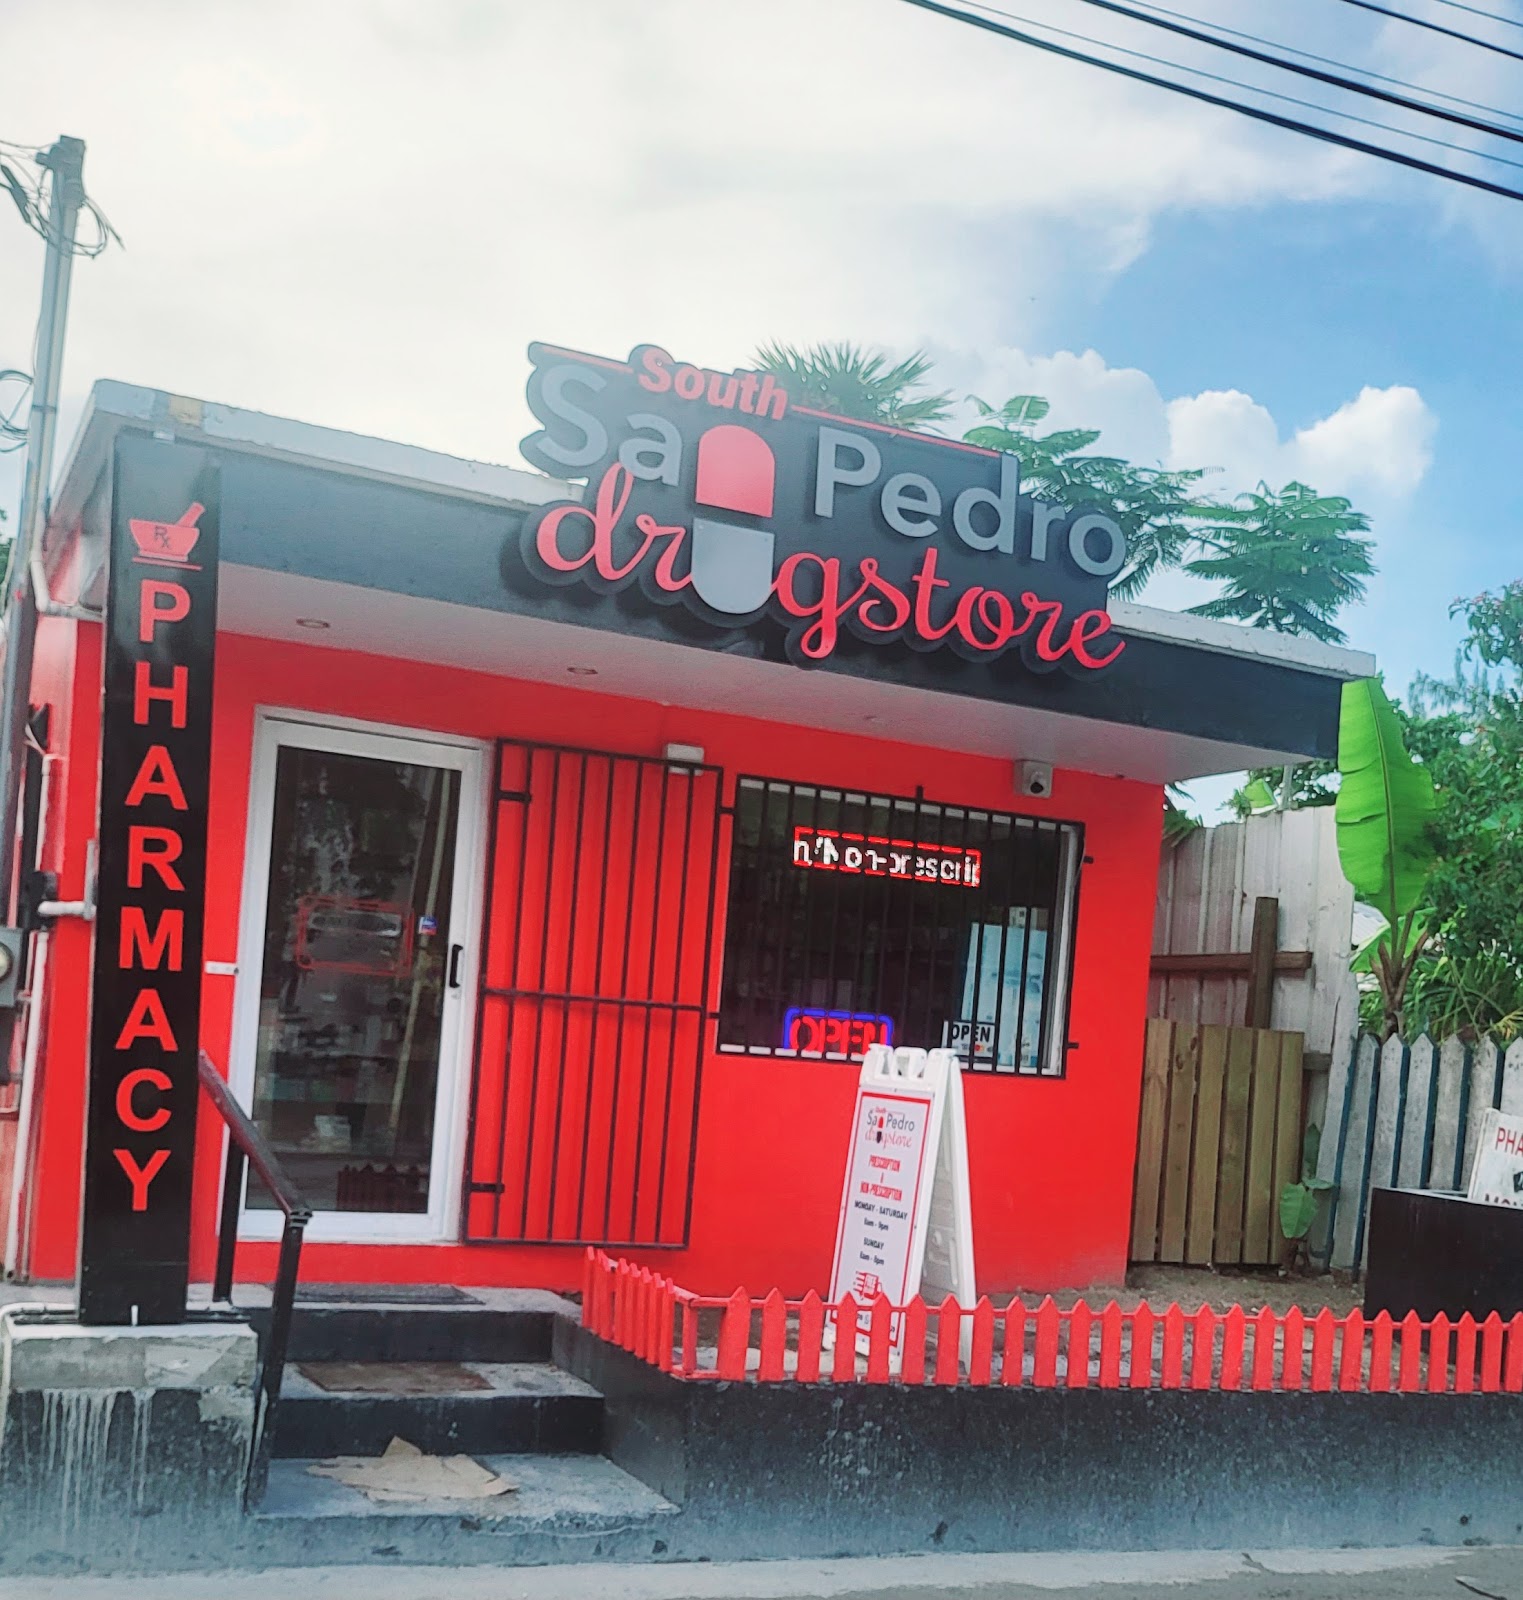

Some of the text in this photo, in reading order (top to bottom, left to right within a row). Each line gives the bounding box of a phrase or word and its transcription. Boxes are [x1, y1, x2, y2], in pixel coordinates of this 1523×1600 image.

[638, 346, 788, 420] South
[814, 426, 1127, 576] Pedro
[114, 579, 190, 1212] PHARMACY
[952, 1024, 991, 1043] OPEN
[886, 1113, 915, 1132] Pedro
[854, 1200, 876, 1212] MONDAY
[879, 1206, 908, 1220] SATURDAY
[863, 1237, 885, 1250] SUNDAY
